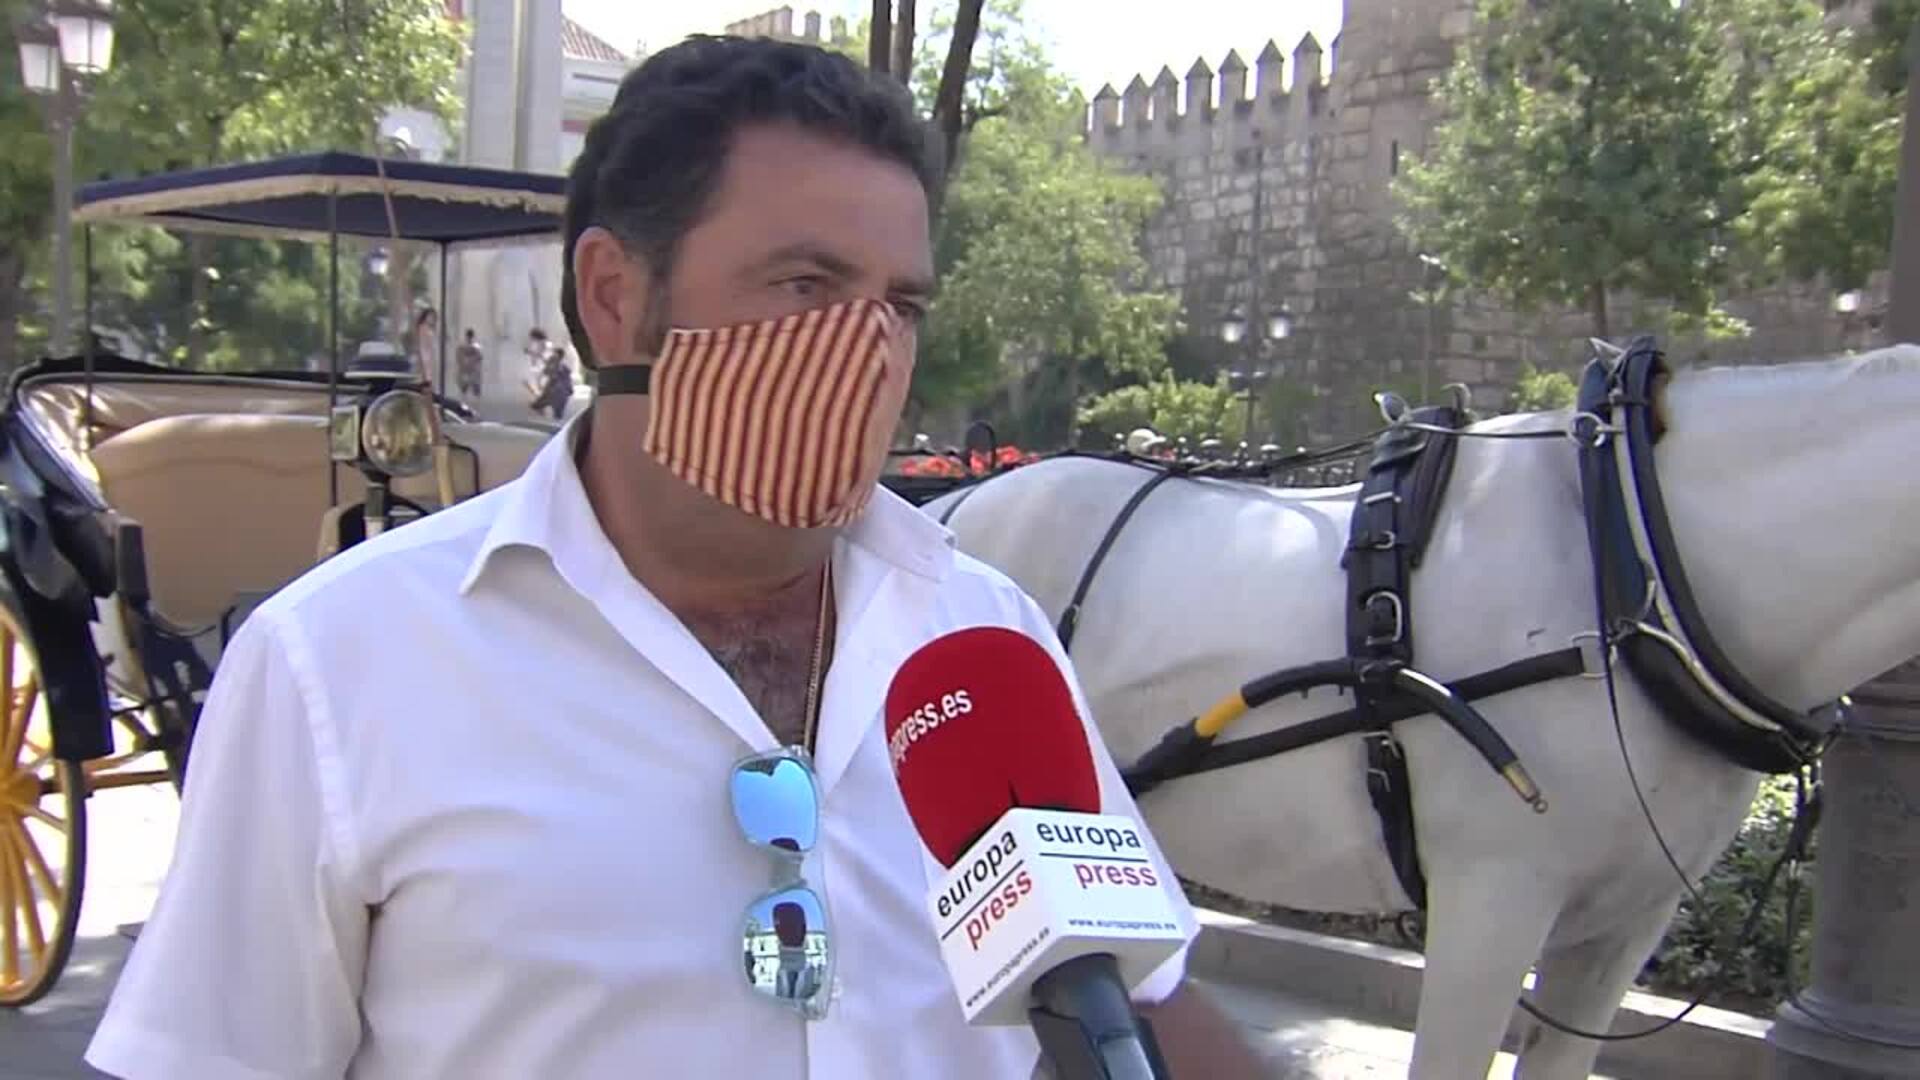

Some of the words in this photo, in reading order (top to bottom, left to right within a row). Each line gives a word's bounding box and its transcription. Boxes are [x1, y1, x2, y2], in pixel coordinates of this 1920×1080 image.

[1036, 823, 1141, 852] europa
[936, 830, 1018, 917] europa
[1073, 863, 1158, 890] press
[966, 870, 1032, 950] press
